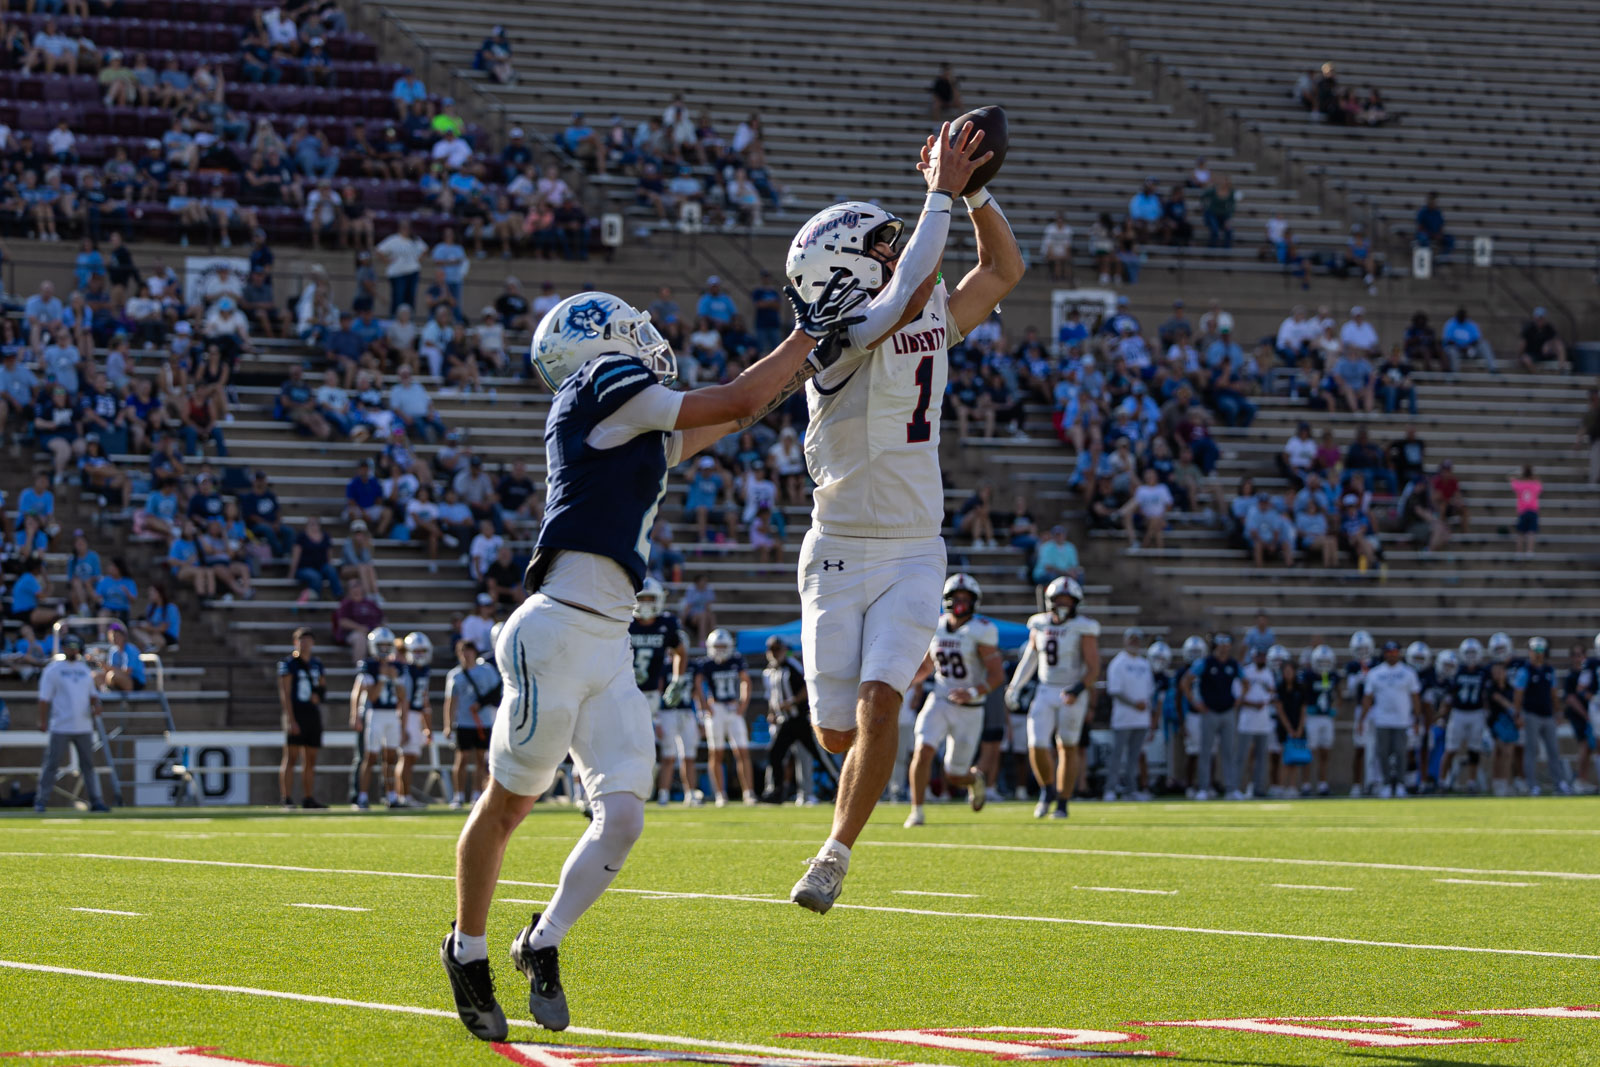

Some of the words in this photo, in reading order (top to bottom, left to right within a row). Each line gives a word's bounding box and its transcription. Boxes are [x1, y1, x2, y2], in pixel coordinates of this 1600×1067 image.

[803, 211, 861, 250] Liberty
[892, 327, 946, 355] LIBERTY
[906, 355, 934, 443] 1
[152, 745, 234, 799] 40
